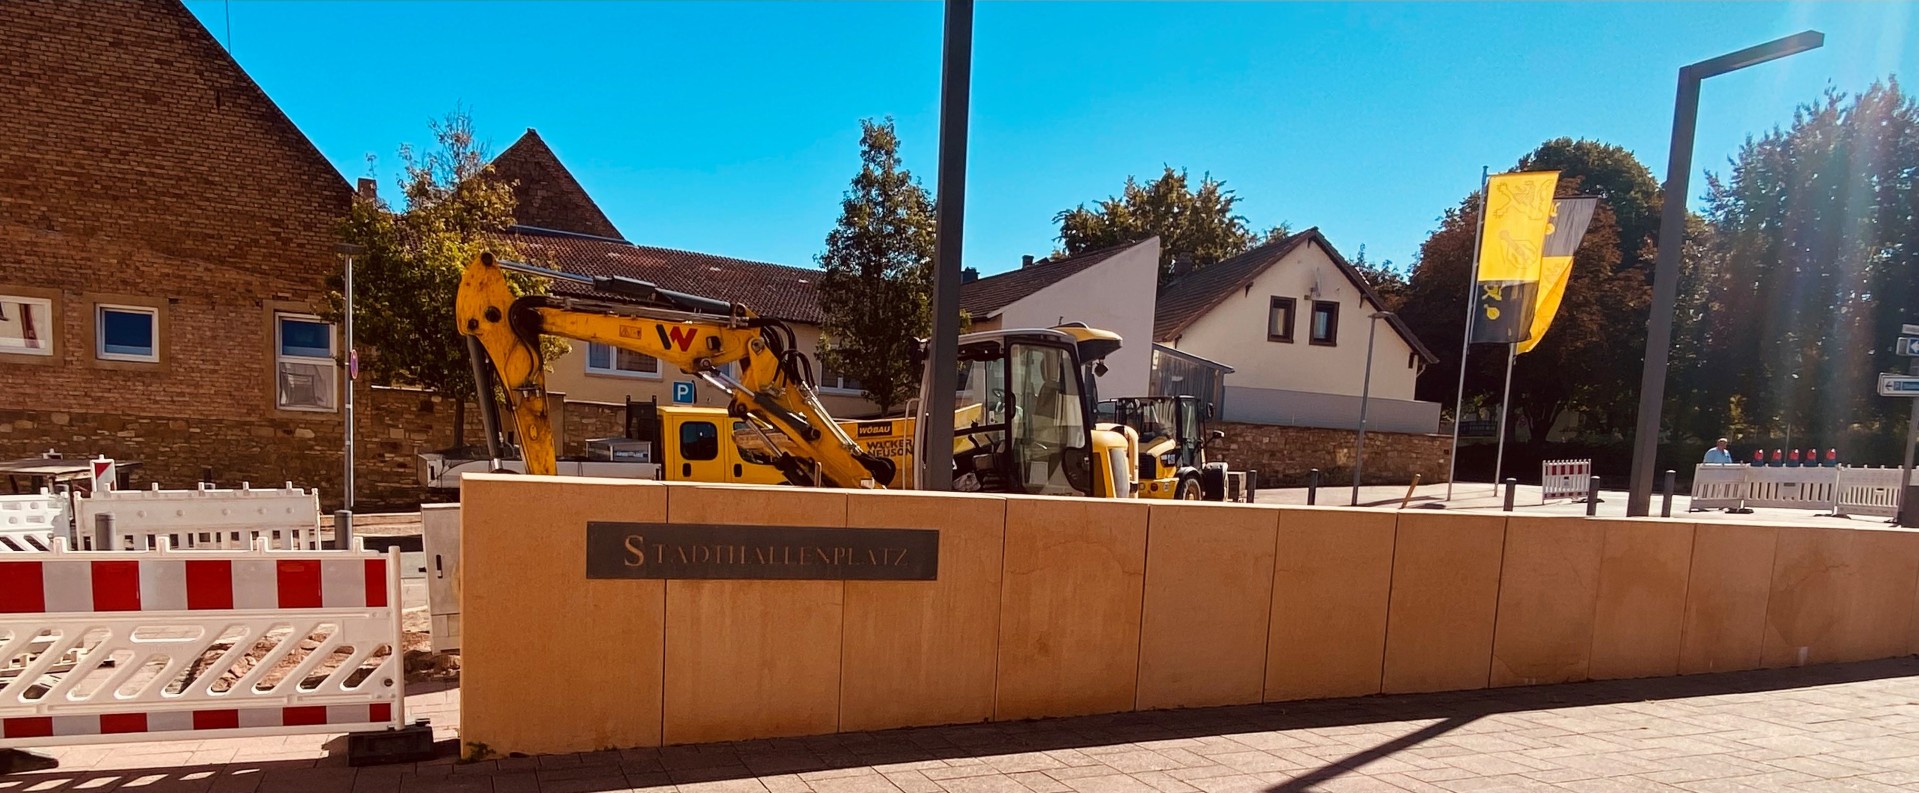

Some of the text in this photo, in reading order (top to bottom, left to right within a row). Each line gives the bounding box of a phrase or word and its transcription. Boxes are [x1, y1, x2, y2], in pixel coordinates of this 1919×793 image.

[677, 384, 689, 401] P
[859, 425, 891, 434] WÖBAU
[866, 439, 912, 450] WACKER
[624, 534, 908, 567] STADTHALLENPLATZ
